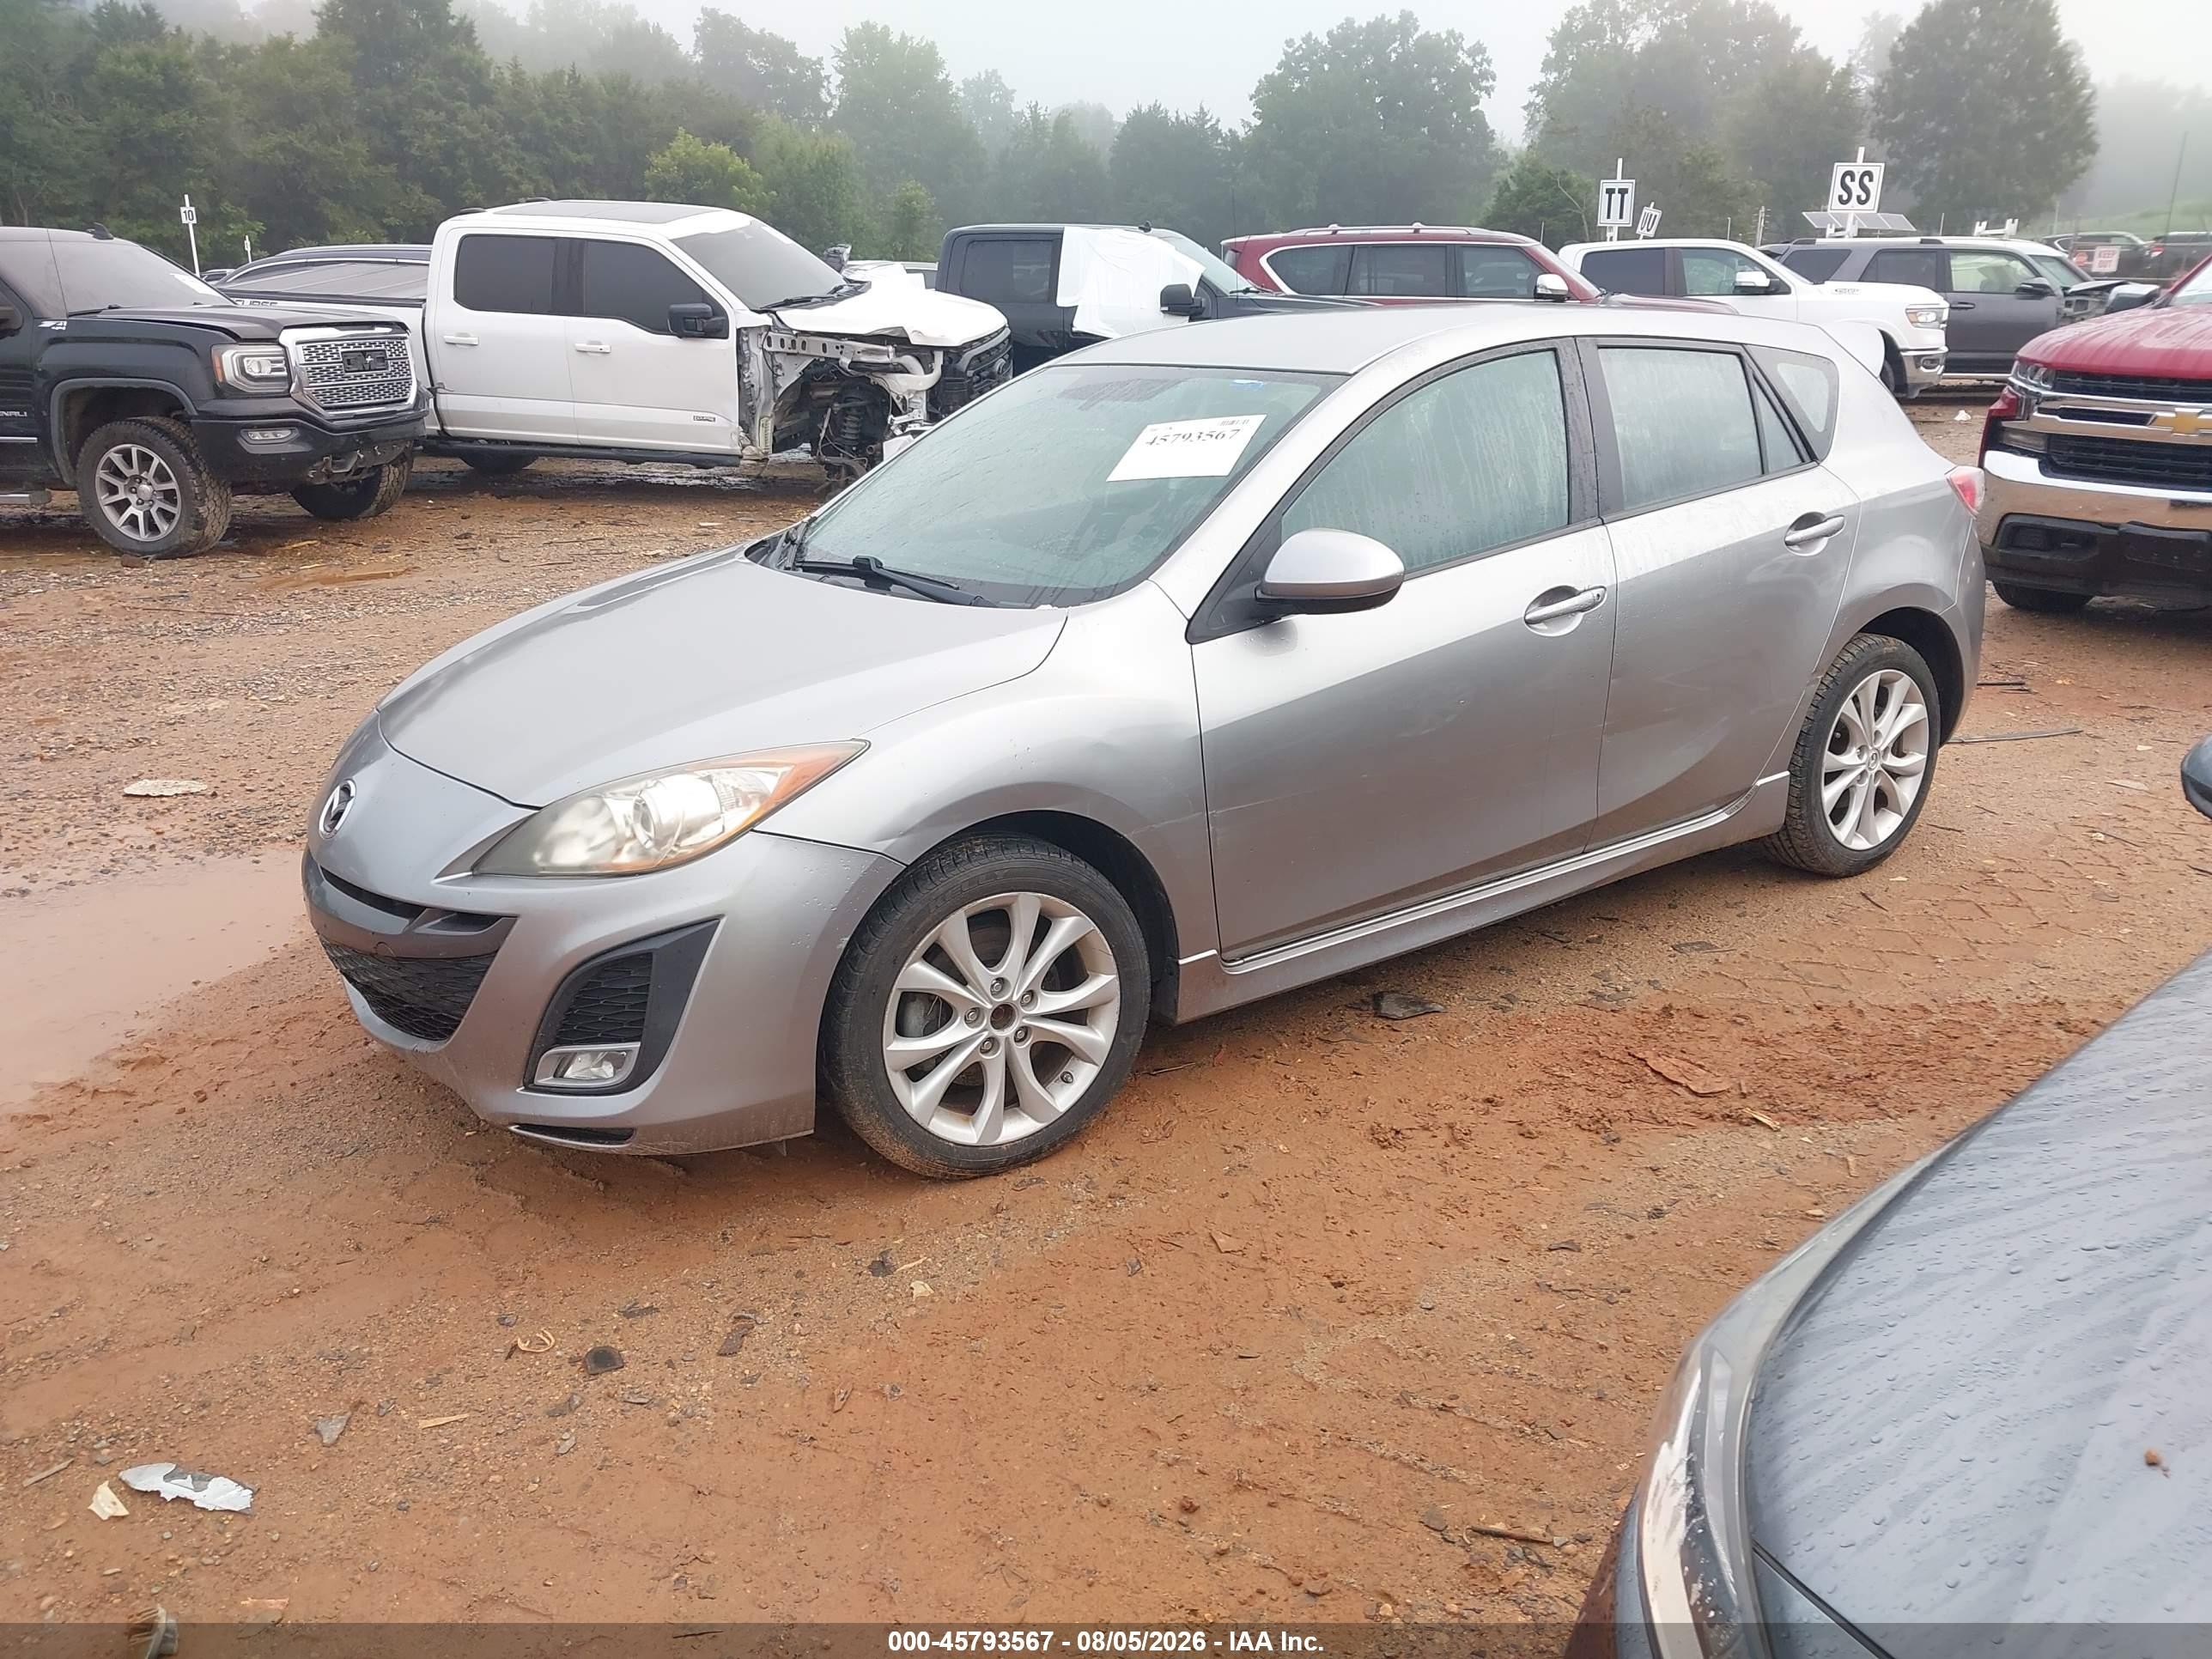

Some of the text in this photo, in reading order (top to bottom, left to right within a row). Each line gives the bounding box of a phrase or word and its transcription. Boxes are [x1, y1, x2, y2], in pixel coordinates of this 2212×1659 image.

[1838, 170, 1874, 205] SS
[1605, 187, 1629, 220] TT
[182, 210, 194, 222] 10
[1640, 211, 1658, 233] UU
[343, 351, 386, 371] GMC
[1145, 428, 1242, 447] 45793567
